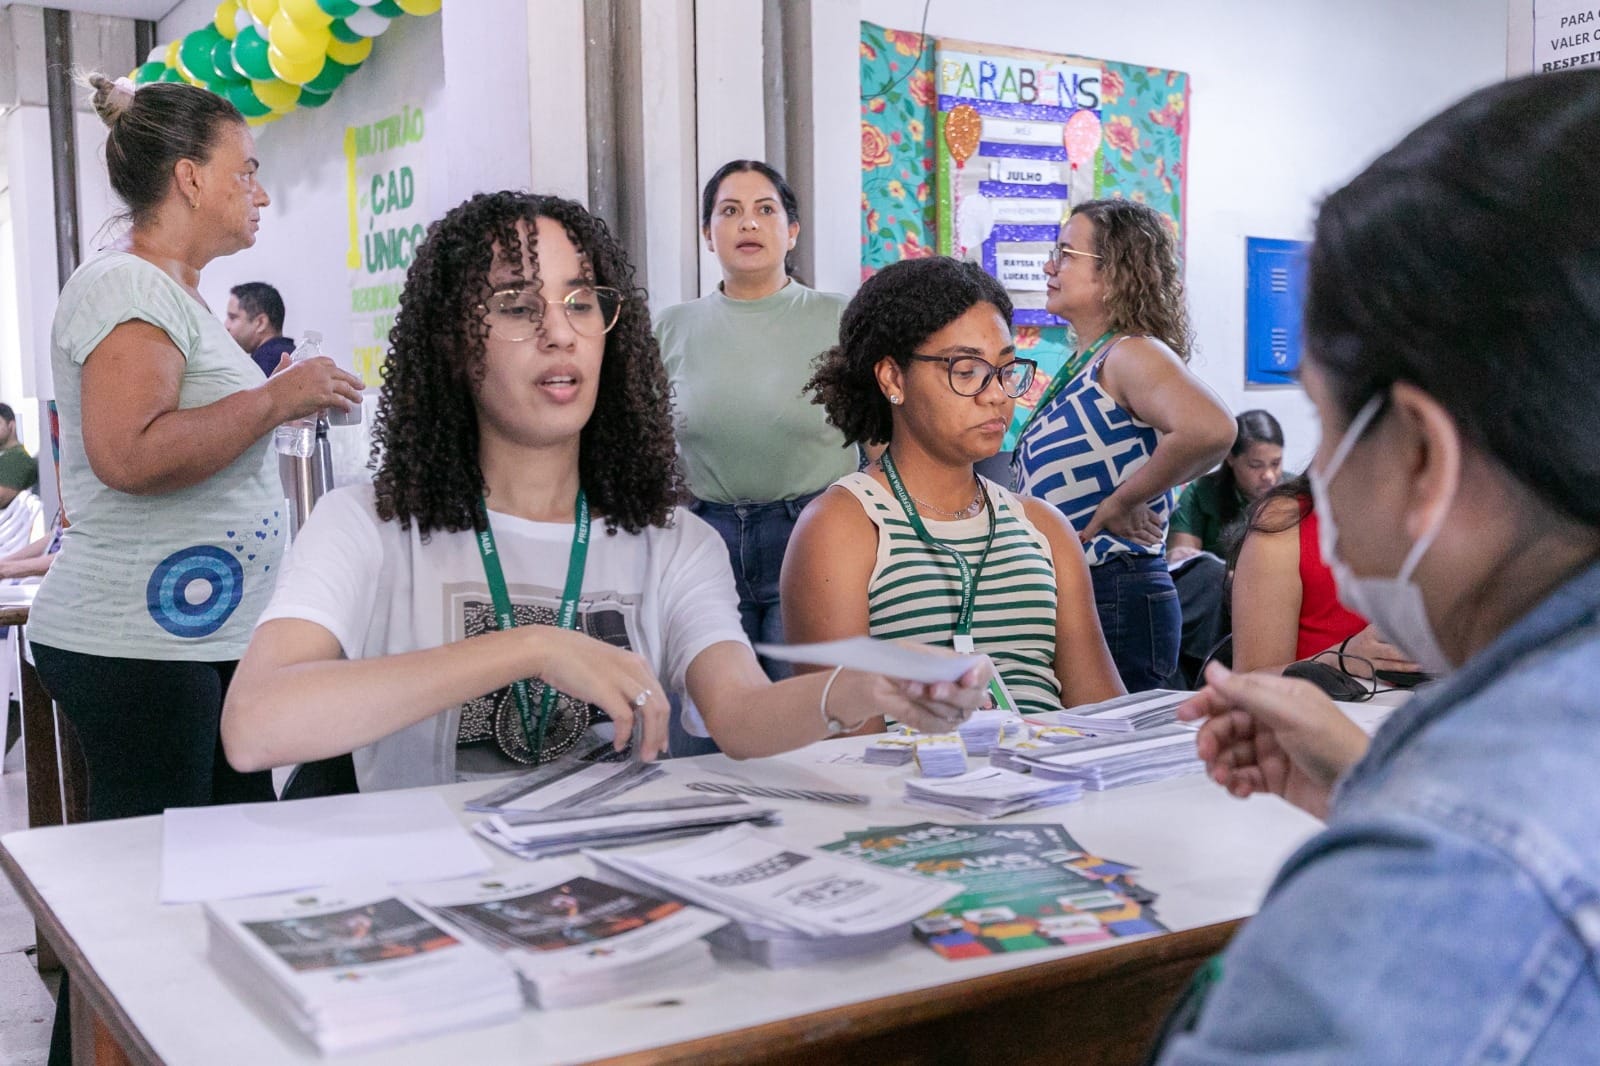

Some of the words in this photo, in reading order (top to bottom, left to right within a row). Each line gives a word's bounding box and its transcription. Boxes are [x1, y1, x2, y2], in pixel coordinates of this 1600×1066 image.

[1560, 10, 1594, 29] PARA
[1551, 32, 1590, 51] VALER
[942, 58, 1099, 109] PARABÉNS
[371, 166, 414, 215] CAD
[1007, 171, 1042, 182] JULHO
[893, 479, 915, 516] PREFEITURA
[960, 583, 971, 625] PREFEITURA
